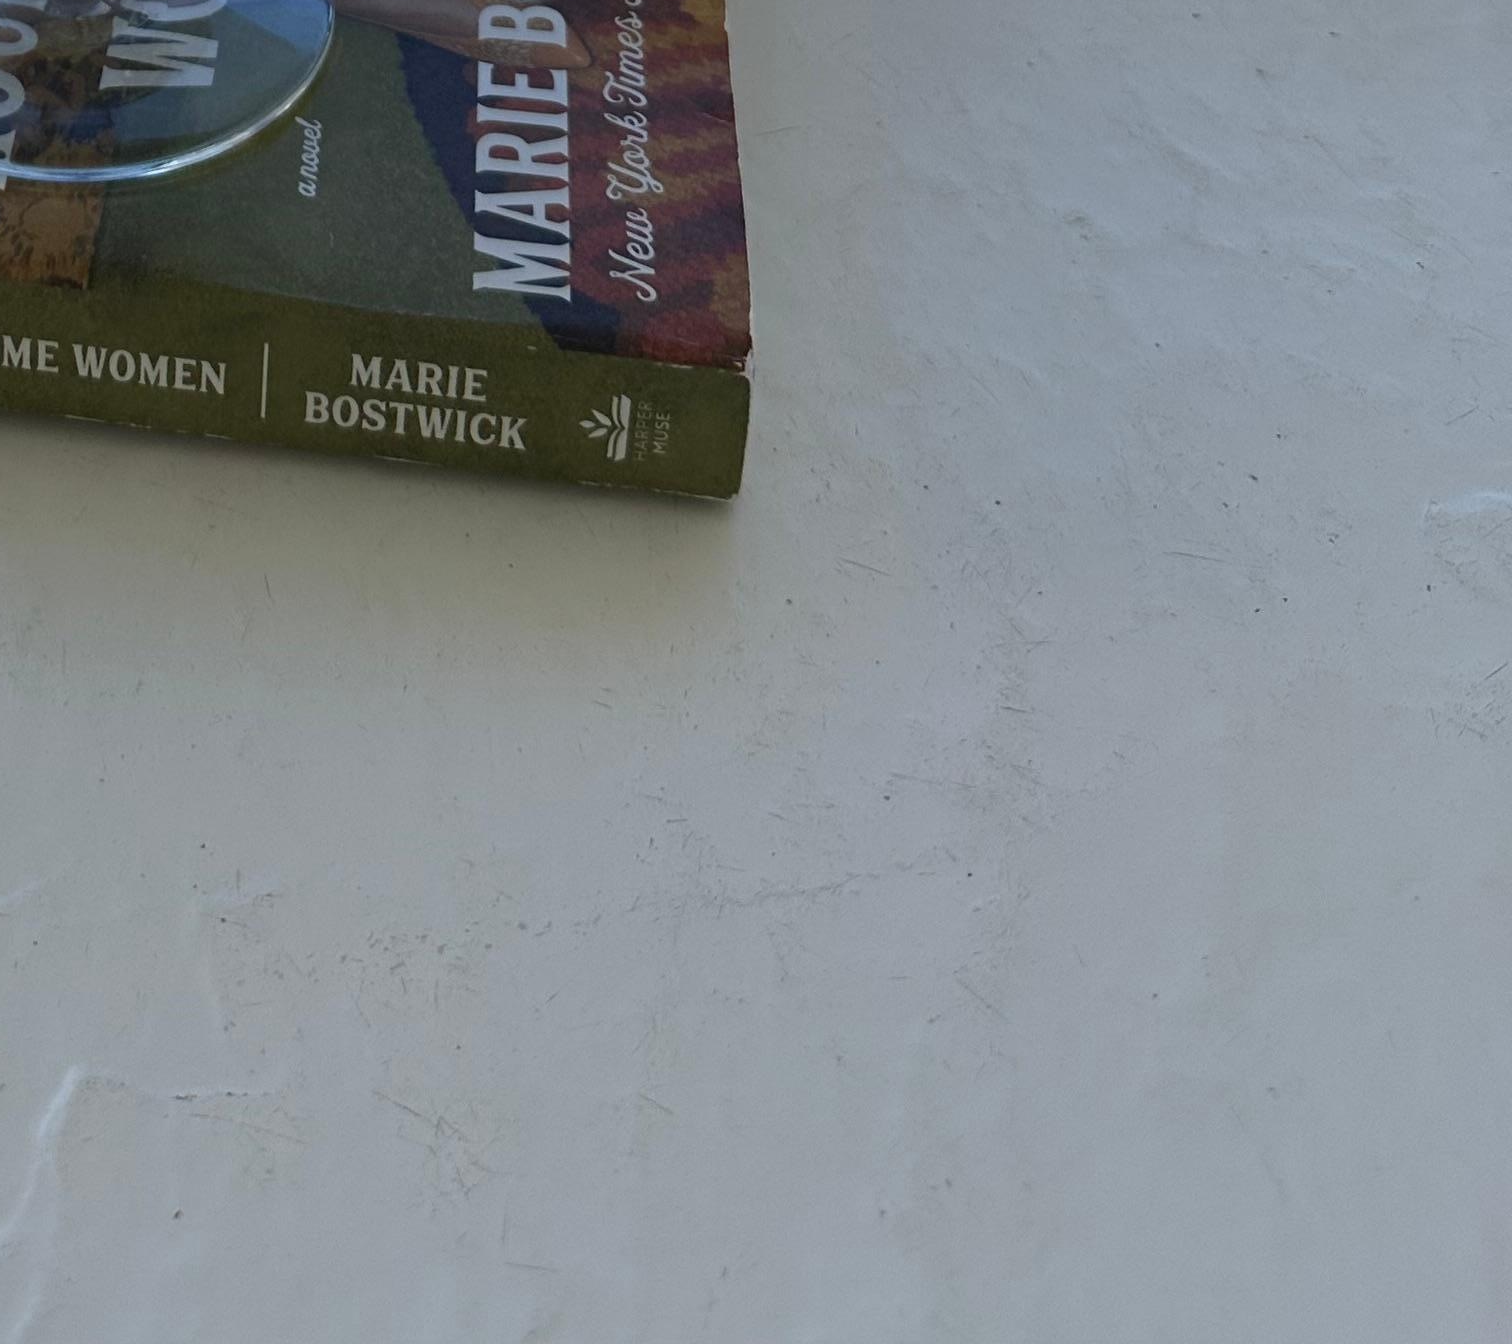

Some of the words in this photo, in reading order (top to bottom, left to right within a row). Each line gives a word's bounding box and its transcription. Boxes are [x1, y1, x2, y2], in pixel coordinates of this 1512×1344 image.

[601, 10, 649, 107] Times
[293, 115, 323, 180] novel
[602, 110, 664, 201] York
[297, 180, 318, 198] a
[472, 60, 572, 304] MARIE
[607, 206, 657, 303] New
[72, 342, 228, 395] WOMEN
[348, 352, 489, 403] MARIE
[303, 389, 529, 451] BOSTWICK
[634, 400, 653, 463] HARPER
[653, 410, 671, 455] MUSE
